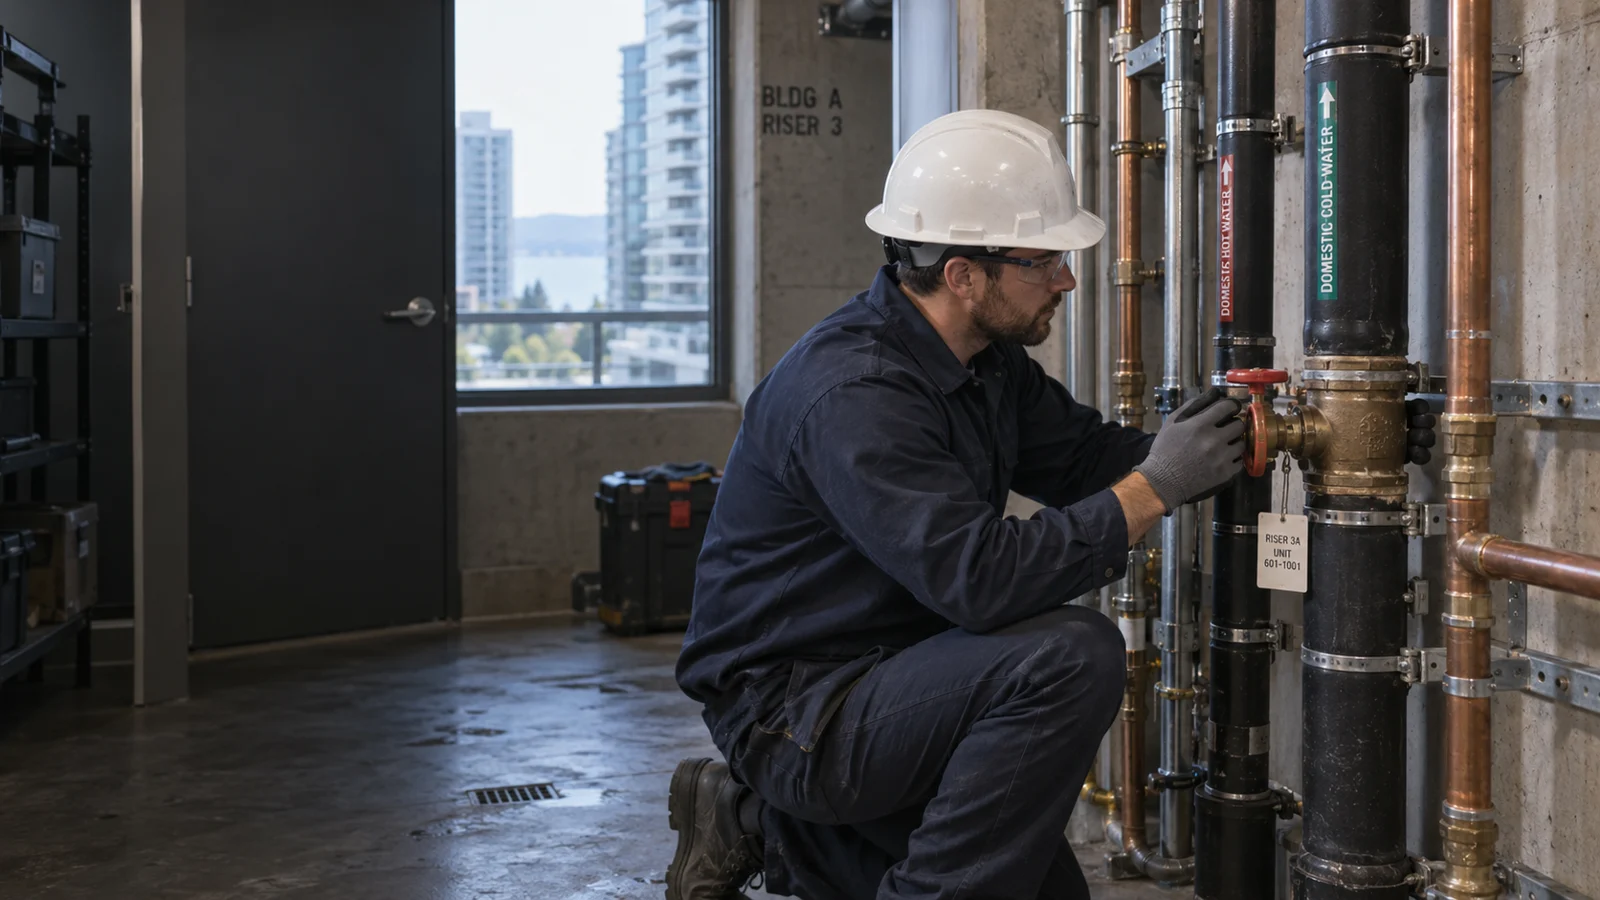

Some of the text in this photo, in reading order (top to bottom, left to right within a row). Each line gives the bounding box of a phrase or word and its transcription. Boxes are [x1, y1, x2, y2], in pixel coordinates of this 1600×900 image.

[762, 86, 842, 109] BLDG A
[763, 114, 843, 136] RISER 3
[1221, 187, 1231, 232] WATER
[1321, 126, 1333, 293] DOMESTIC COLD WATER
[1221, 234, 1230, 258] HOT
[1265, 534, 1301, 546] RISER 3A
[1273, 548, 1292, 558] UNIT
[1264, 559, 1301, 571] 601-1001
